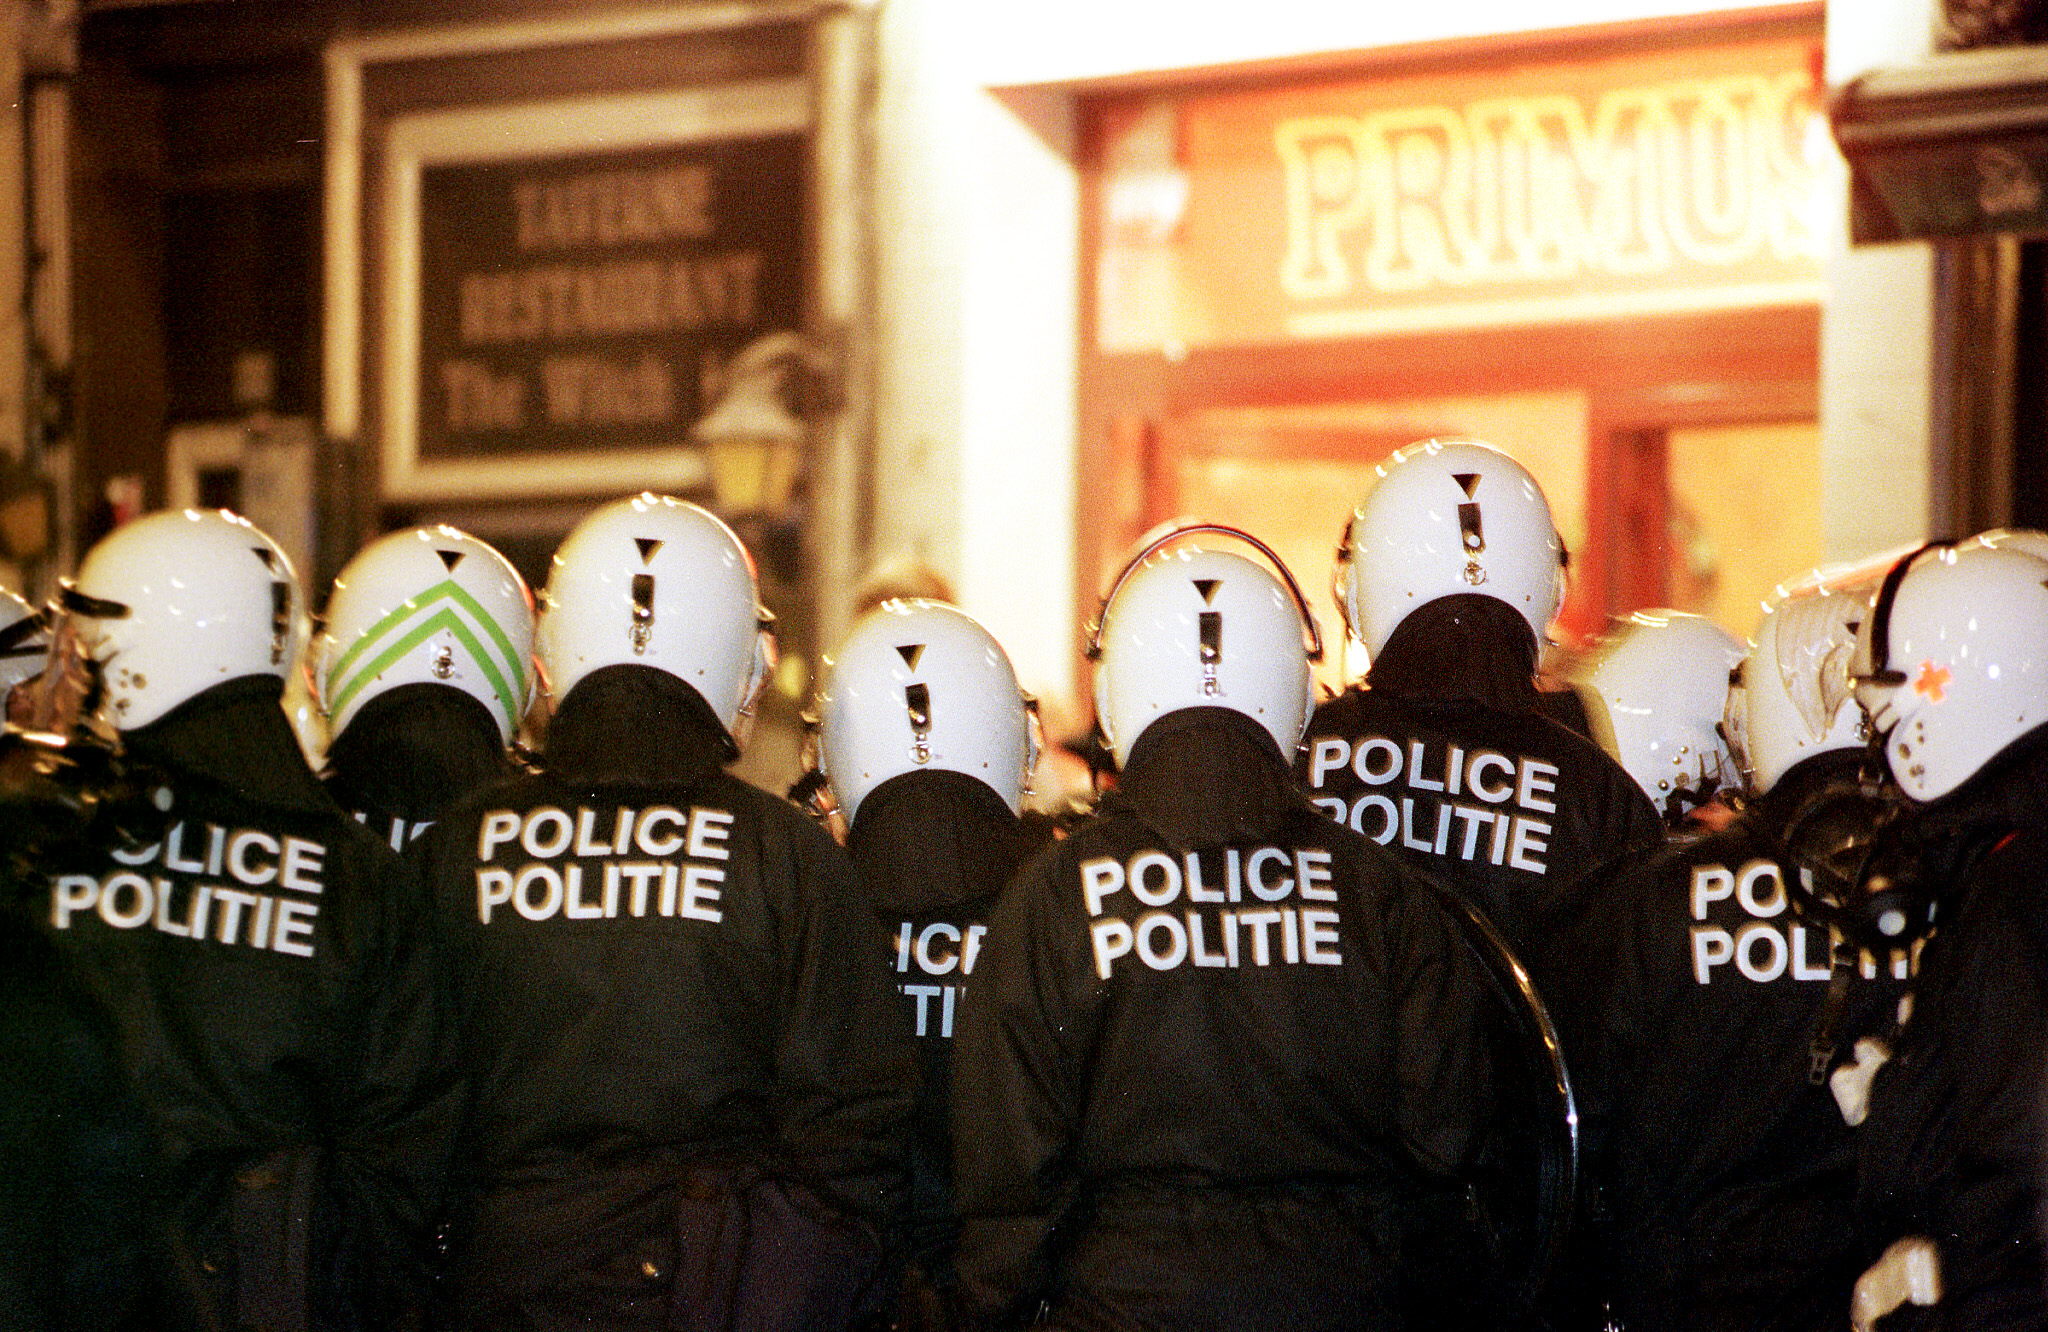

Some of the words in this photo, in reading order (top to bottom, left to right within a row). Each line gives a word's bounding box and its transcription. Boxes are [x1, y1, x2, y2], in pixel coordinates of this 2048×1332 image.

[1310, 736, 1559, 813] POLICE
[111, 820, 326, 894] LICE
[478, 806, 734, 862] POLICE
[52, 874, 320, 958] POLITIE
[475, 861, 725, 925] POLITIE
[1080, 847, 1338, 916] POLICE
[1090, 908, 1342, 980] POLITIE
